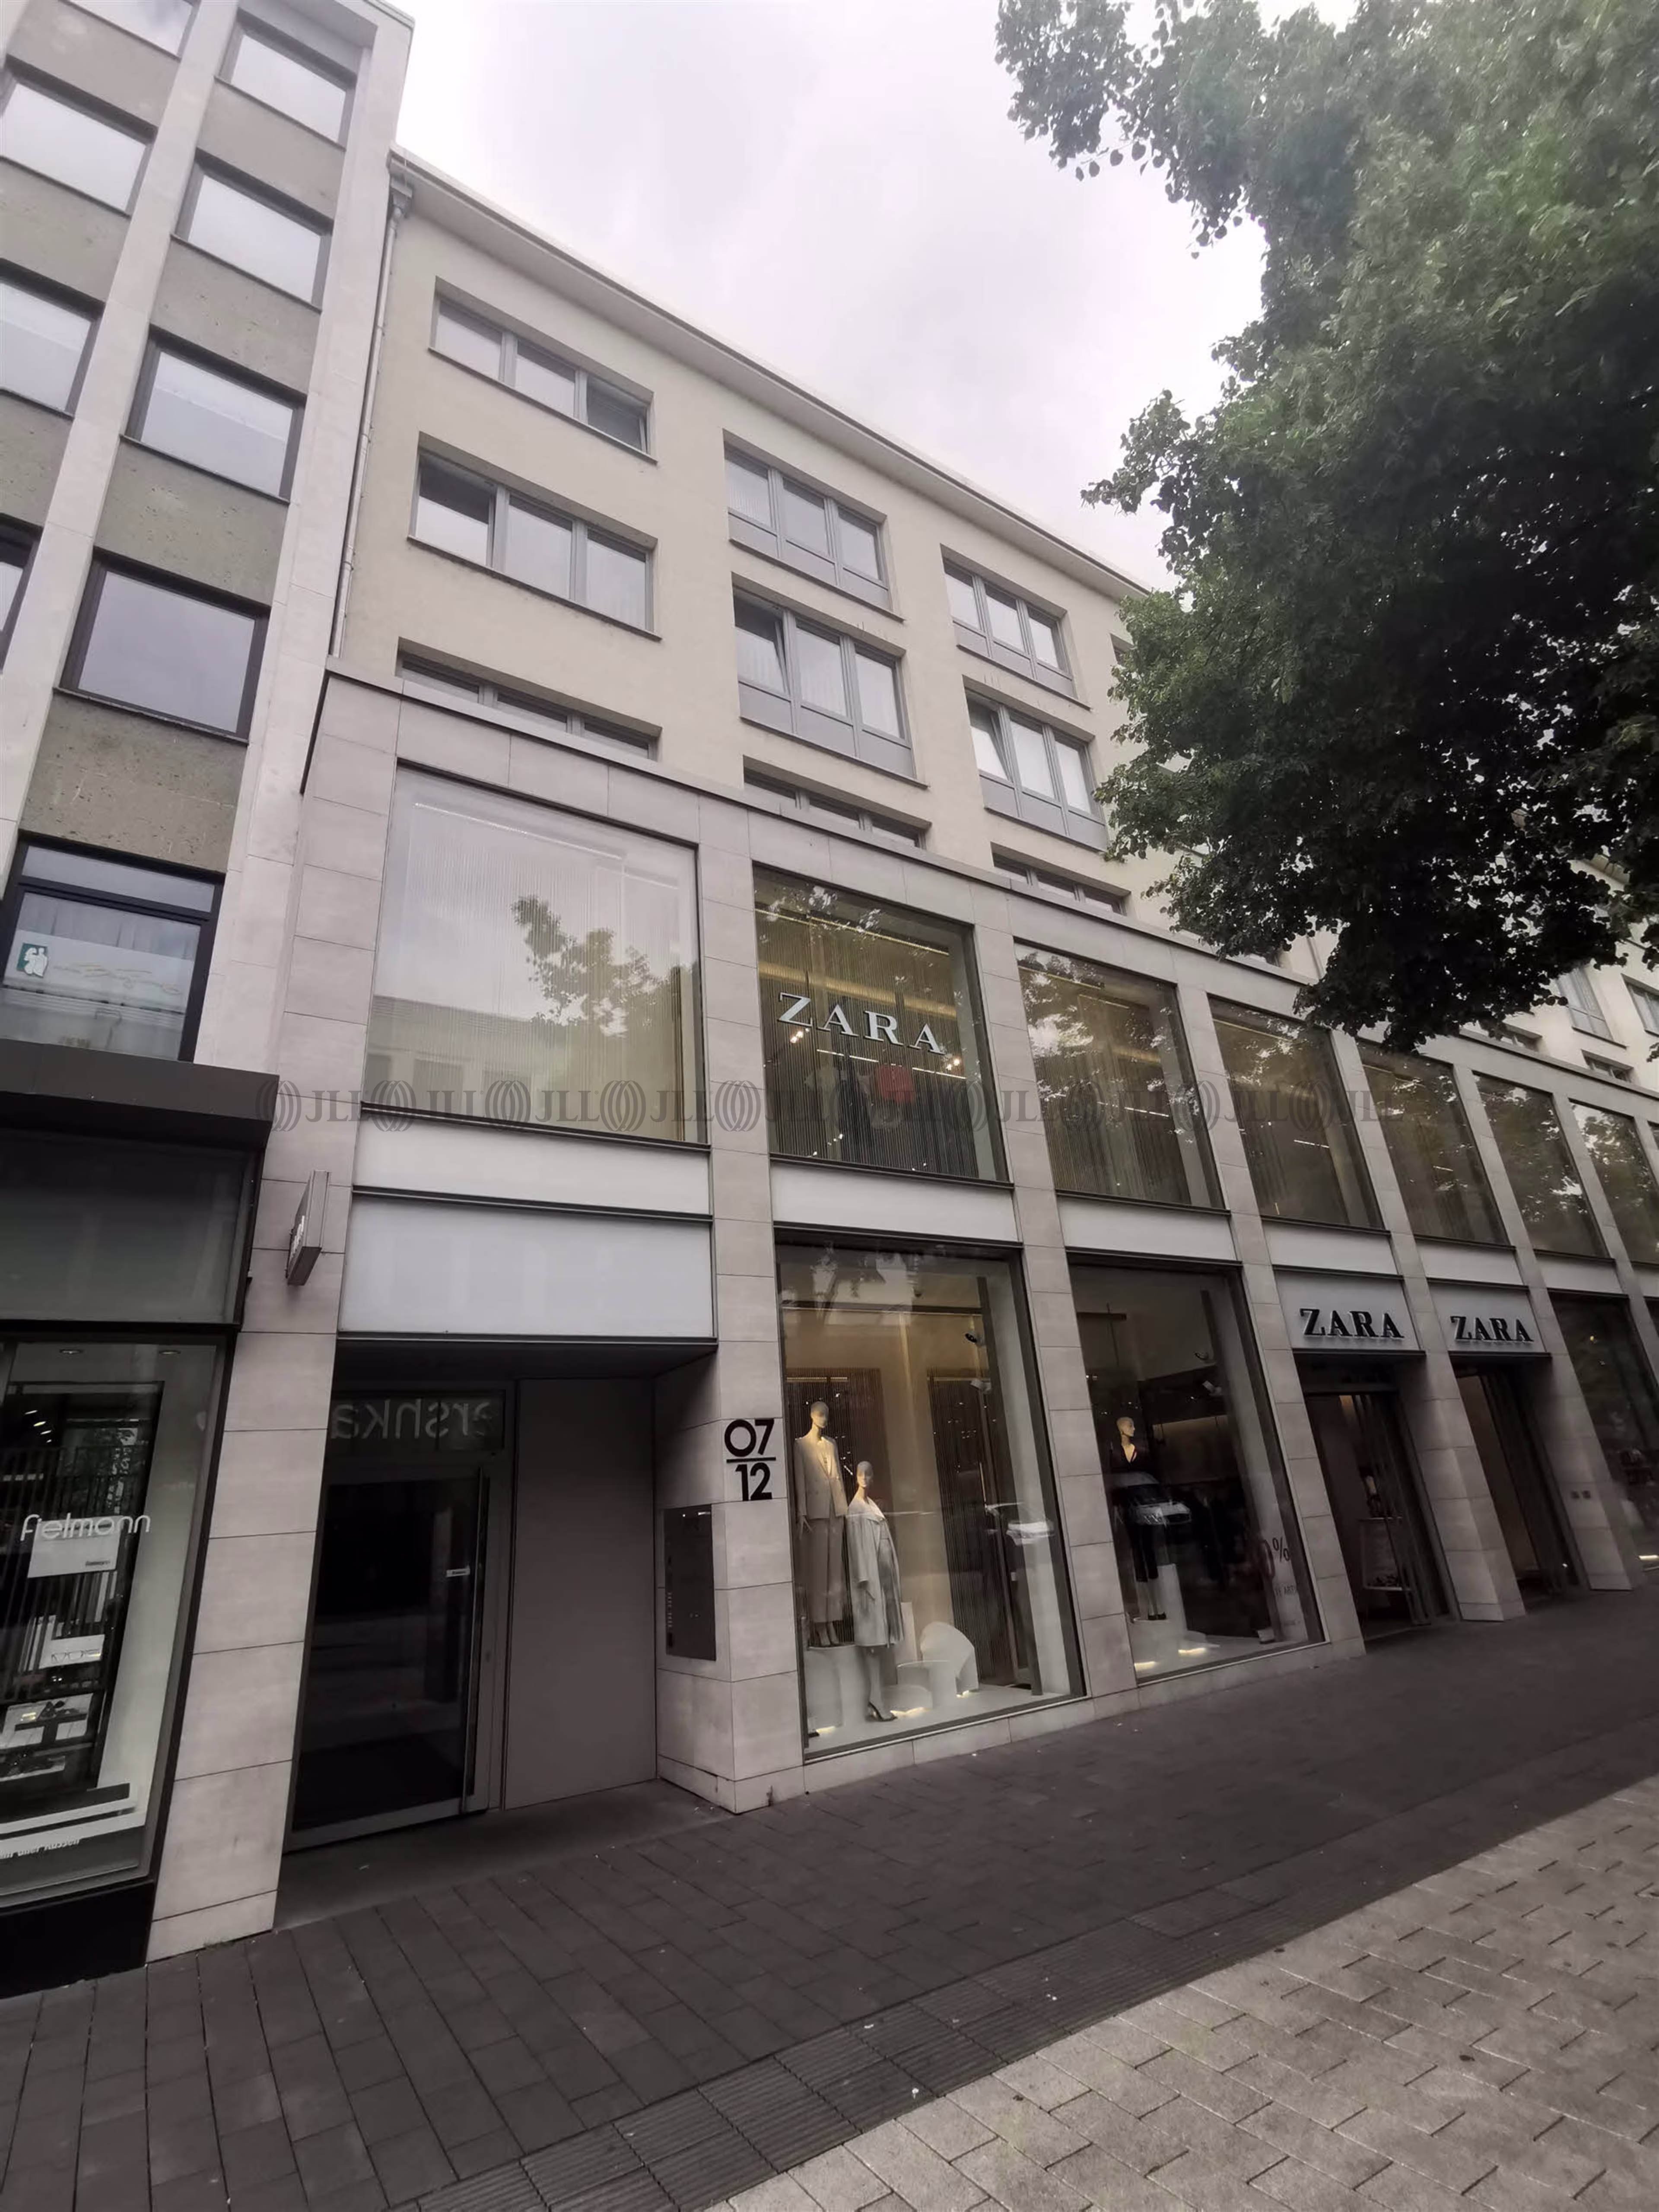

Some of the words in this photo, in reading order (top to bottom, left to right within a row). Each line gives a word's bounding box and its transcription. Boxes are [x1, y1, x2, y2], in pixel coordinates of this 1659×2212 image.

[777, 992, 946, 1055] ZARA
[1299, 1307, 1405, 1338] ZARA
[1450, 1315, 1535, 1342] ZARA
[724, 1418, 775, 1458] 07
[734, 1462, 773, 1501] 12
[20, 1512, 152, 1541] fielmann
